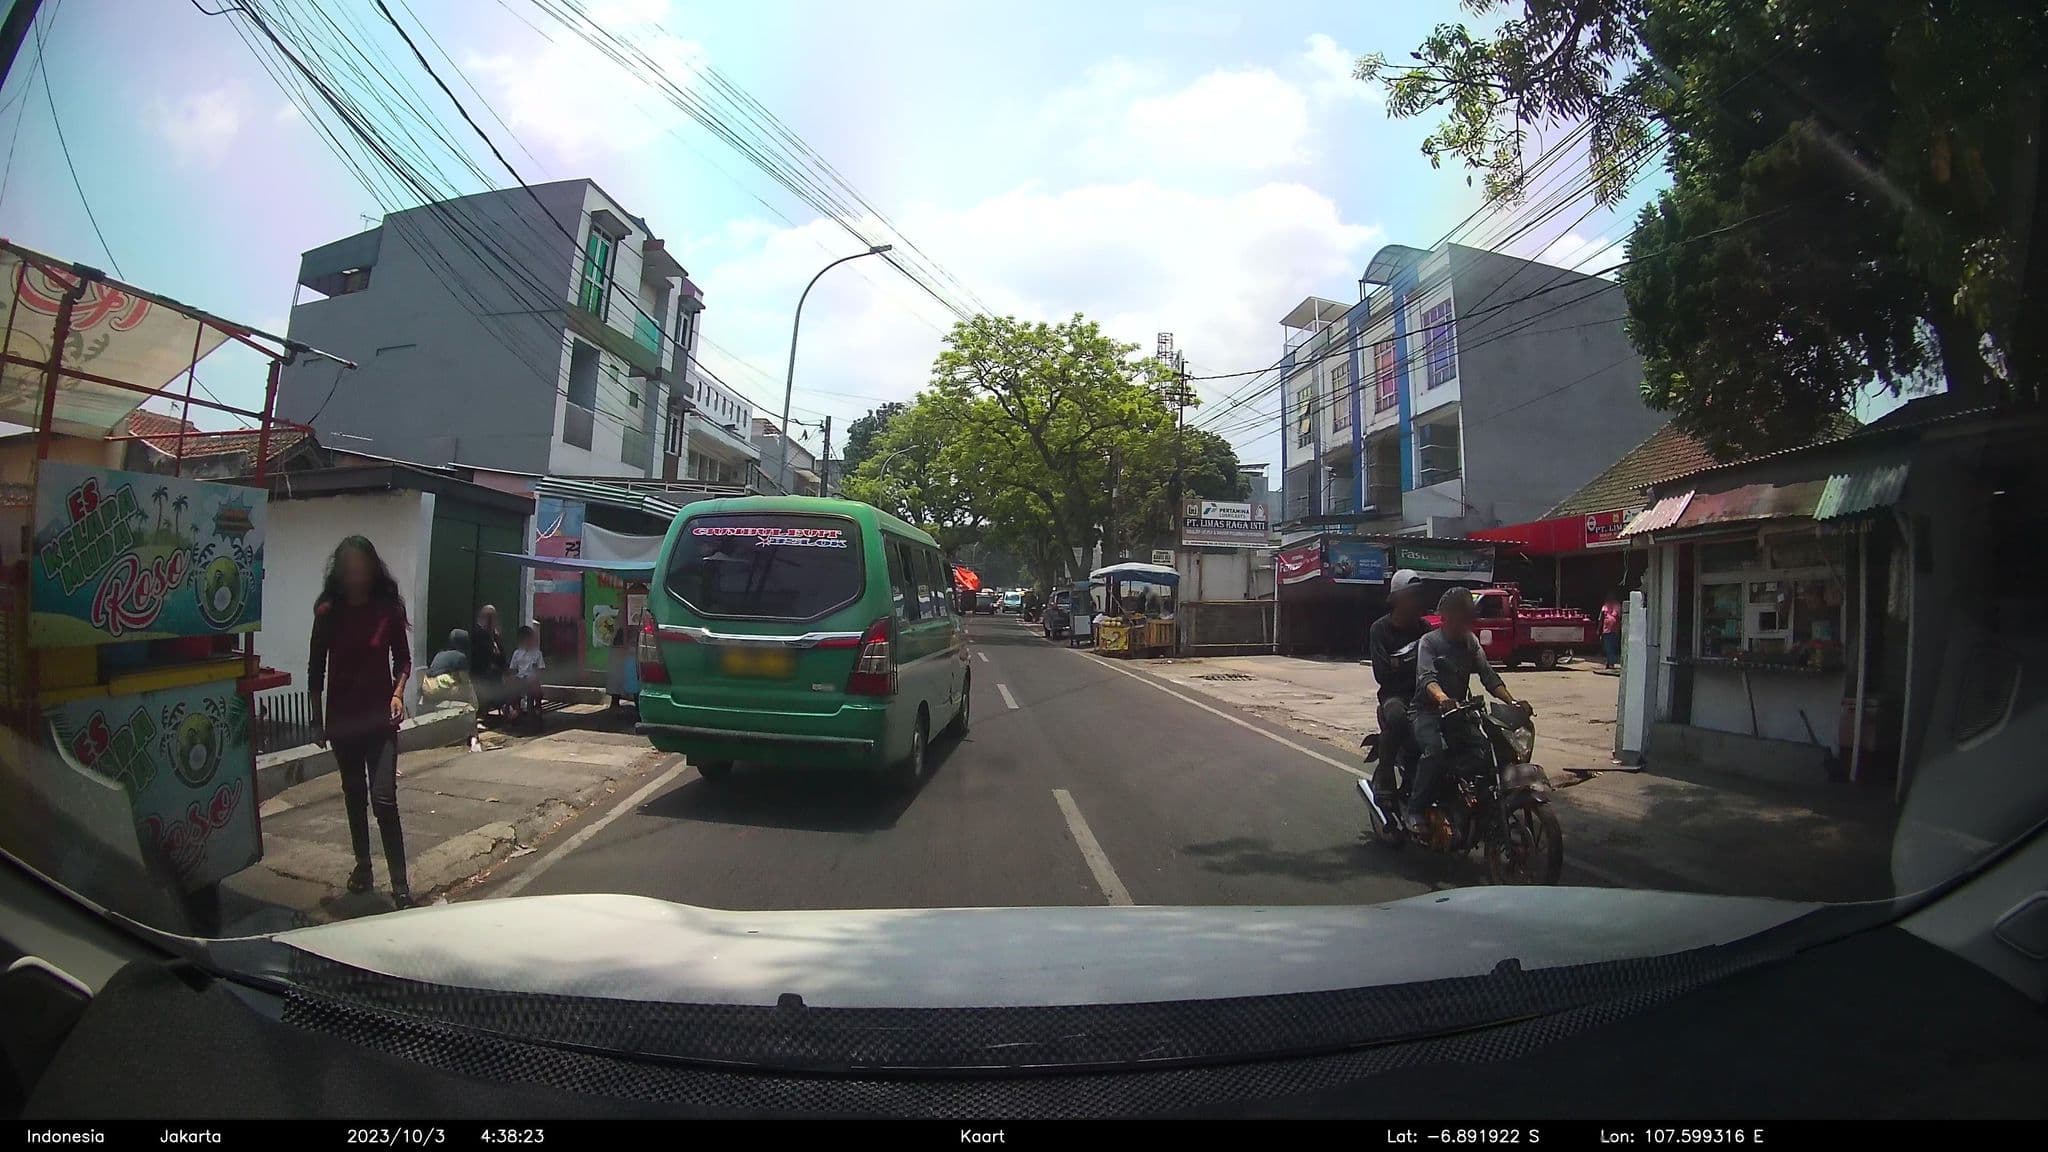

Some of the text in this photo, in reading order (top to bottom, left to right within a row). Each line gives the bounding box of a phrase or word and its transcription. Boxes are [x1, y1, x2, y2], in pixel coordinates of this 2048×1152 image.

[40, 483, 138, 579] KELAPA
[66, 477, 99, 522] ES
[1186, 518, 1265, 530] PT. LIMAS RAGA INTI
[60, 518, 134, 596] MUDA
[92, 548, 192, 637] Roso
[72, 710, 111, 767] ES
